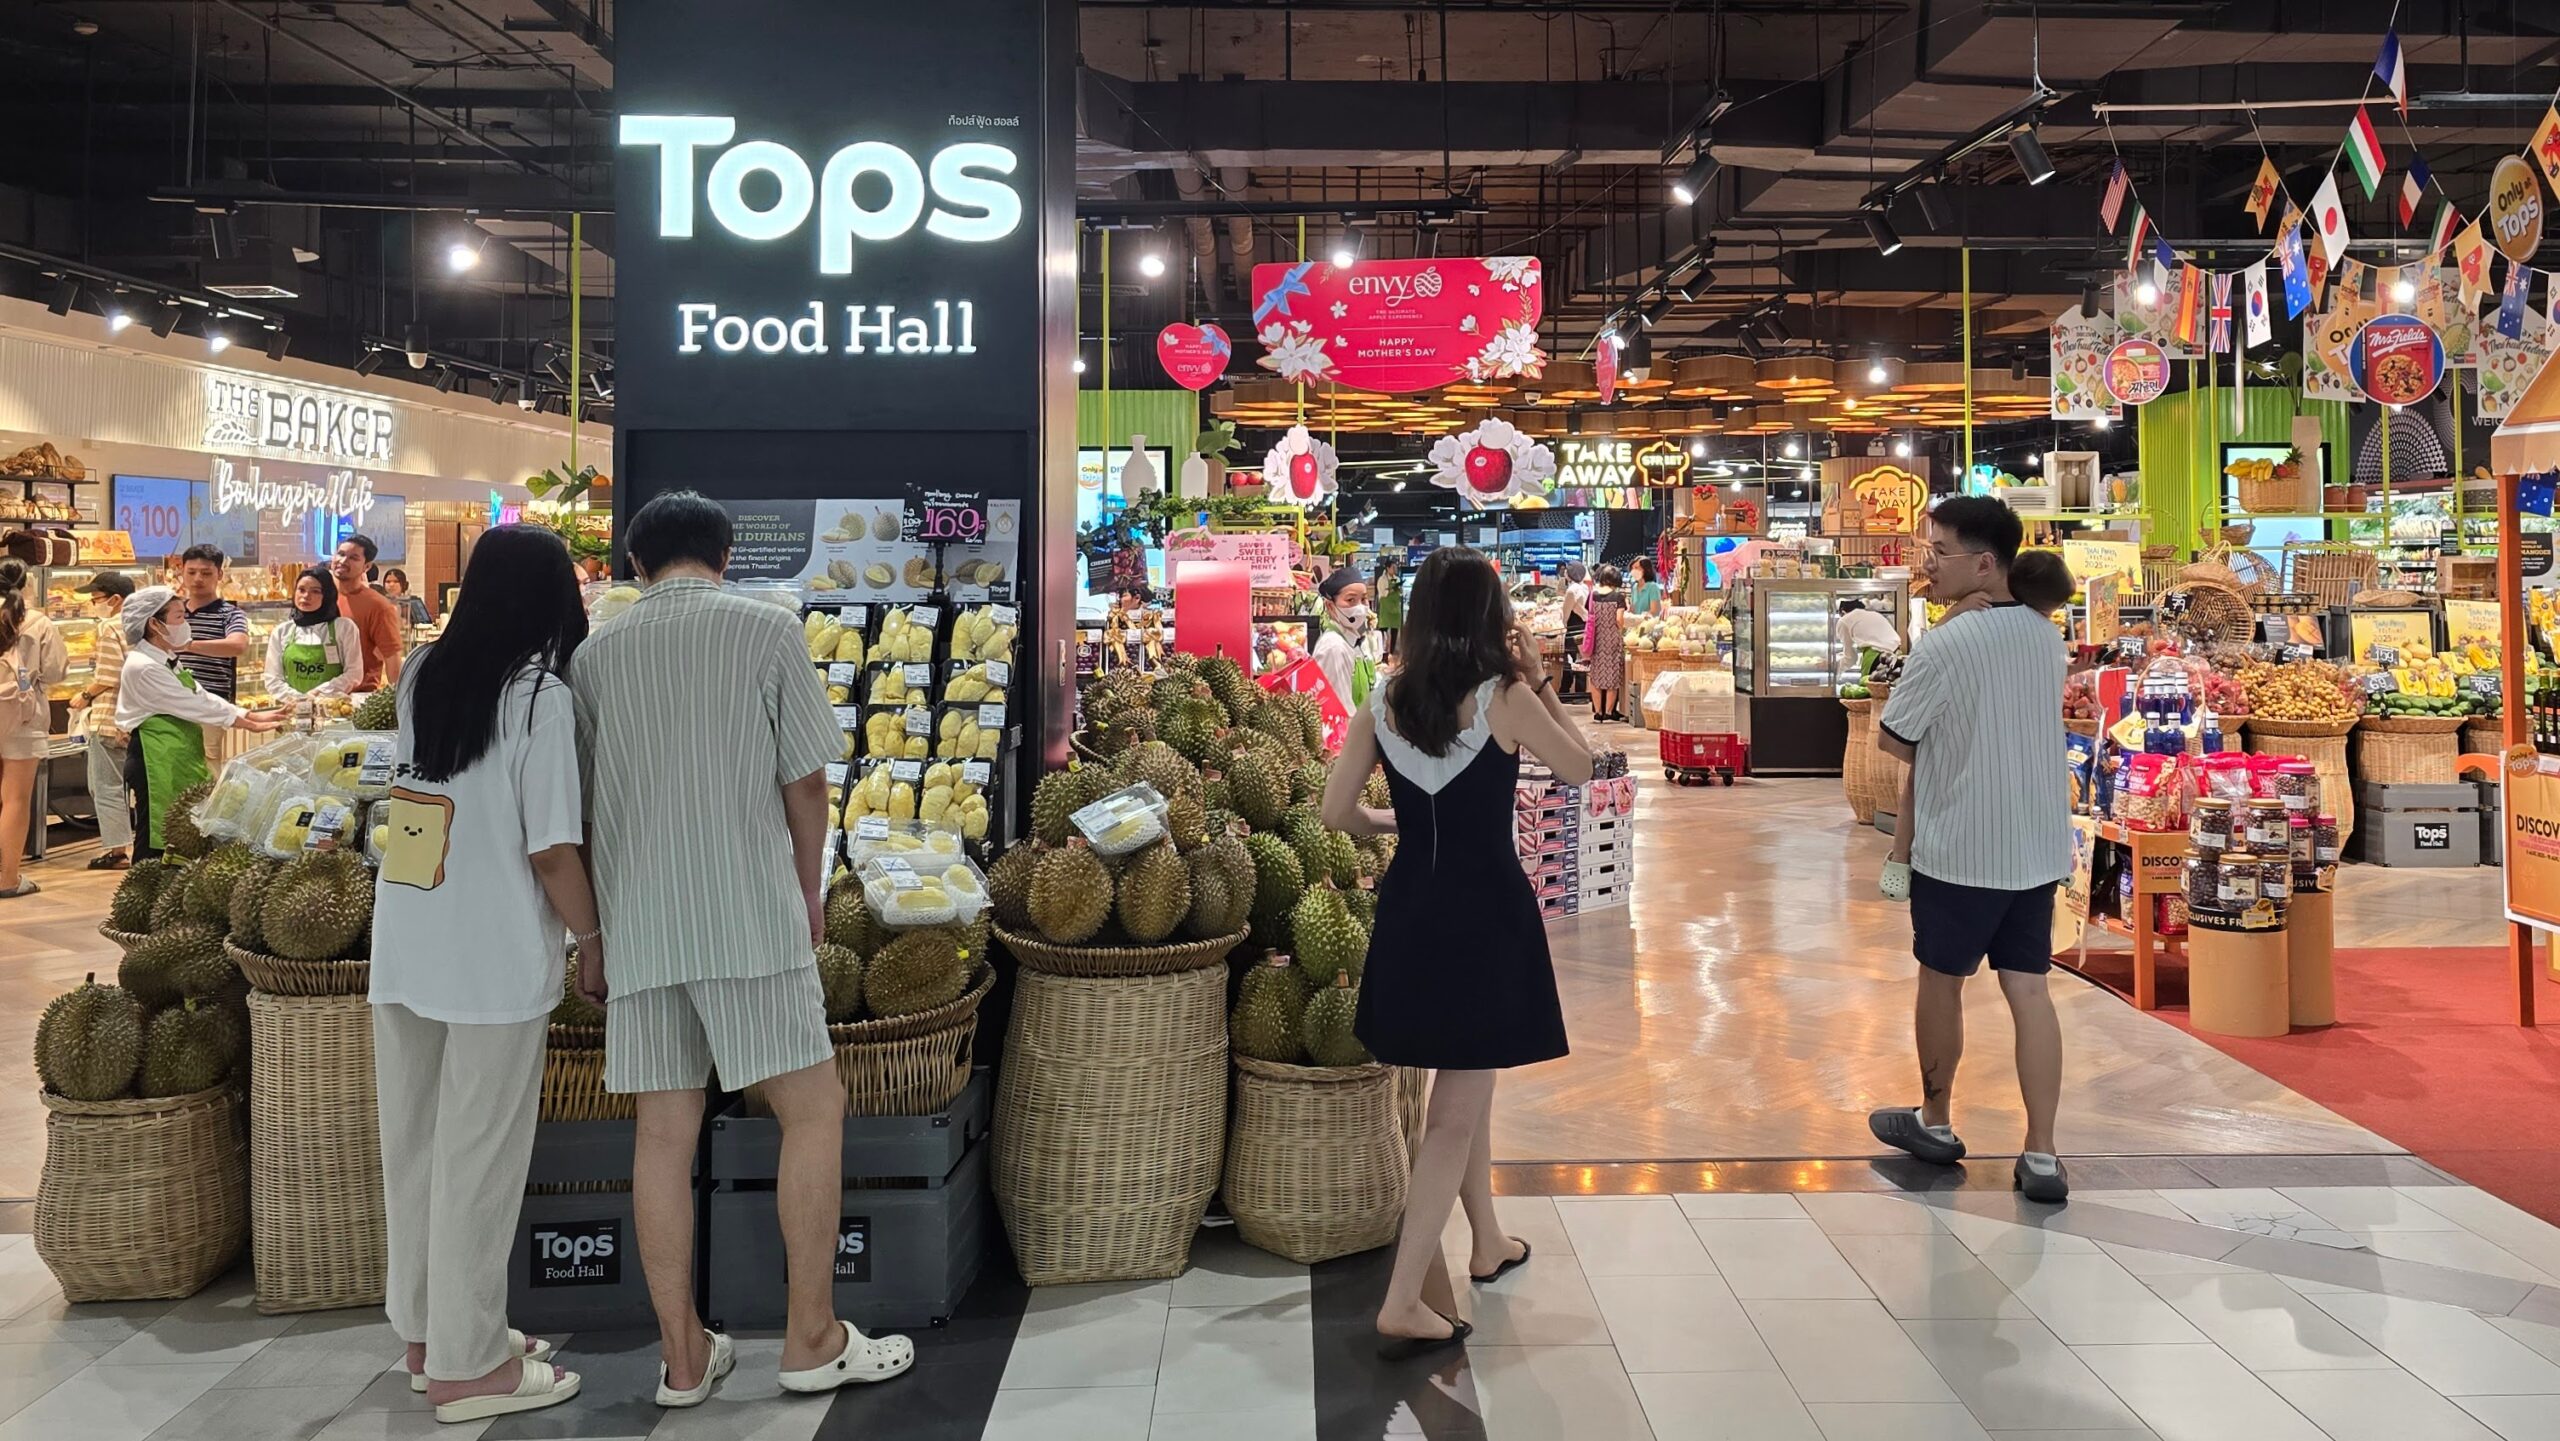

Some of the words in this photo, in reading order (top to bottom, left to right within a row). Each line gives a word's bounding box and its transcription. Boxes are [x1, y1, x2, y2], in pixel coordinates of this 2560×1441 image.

[619, 115, 1022, 274] Tops
[2498, 182, 2523, 212] Only
[2498, 195, 2540, 243] Tops
[1349, 275, 1415, 307] envy
[678, 301, 829, 354] Food
[845, 300, 977, 354] Hall
[1379, 338, 1415, 346] HAPPY
[1358, 349, 1411, 358] MOTHER'S
[1415, 348, 1436, 356] DAY
[1177, 364, 1201, 377] envy
[215, 380, 260, 418] THE
[265, 391, 393, 460] BAKER
[1561, 443, 1632, 463] TAKE
[1558, 464, 1636, 485] AWAY
[218, 461, 328, 527] Boulangerie
[1871, 487, 1906, 497] TAKE
[1877, 499, 1909, 509] WAY
[120, 504, 132, 534] 3
[142, 503, 179, 538] 100
[738, 514, 780, 522] DISCOVER
[920, 508, 980, 537] 169
[745, 532, 806, 541] DURIANS
[293, 660, 325, 675] Tops
[2415, 826, 2447, 841] Tops
[2142, 856, 2183, 867] DISCO
[2189, 911, 2226, 926] CLUSIVES
[534, 1231, 614, 1265] Tops
[545, 1265, 575, 1279] Food
[578, 1264, 604, 1278] Hall
